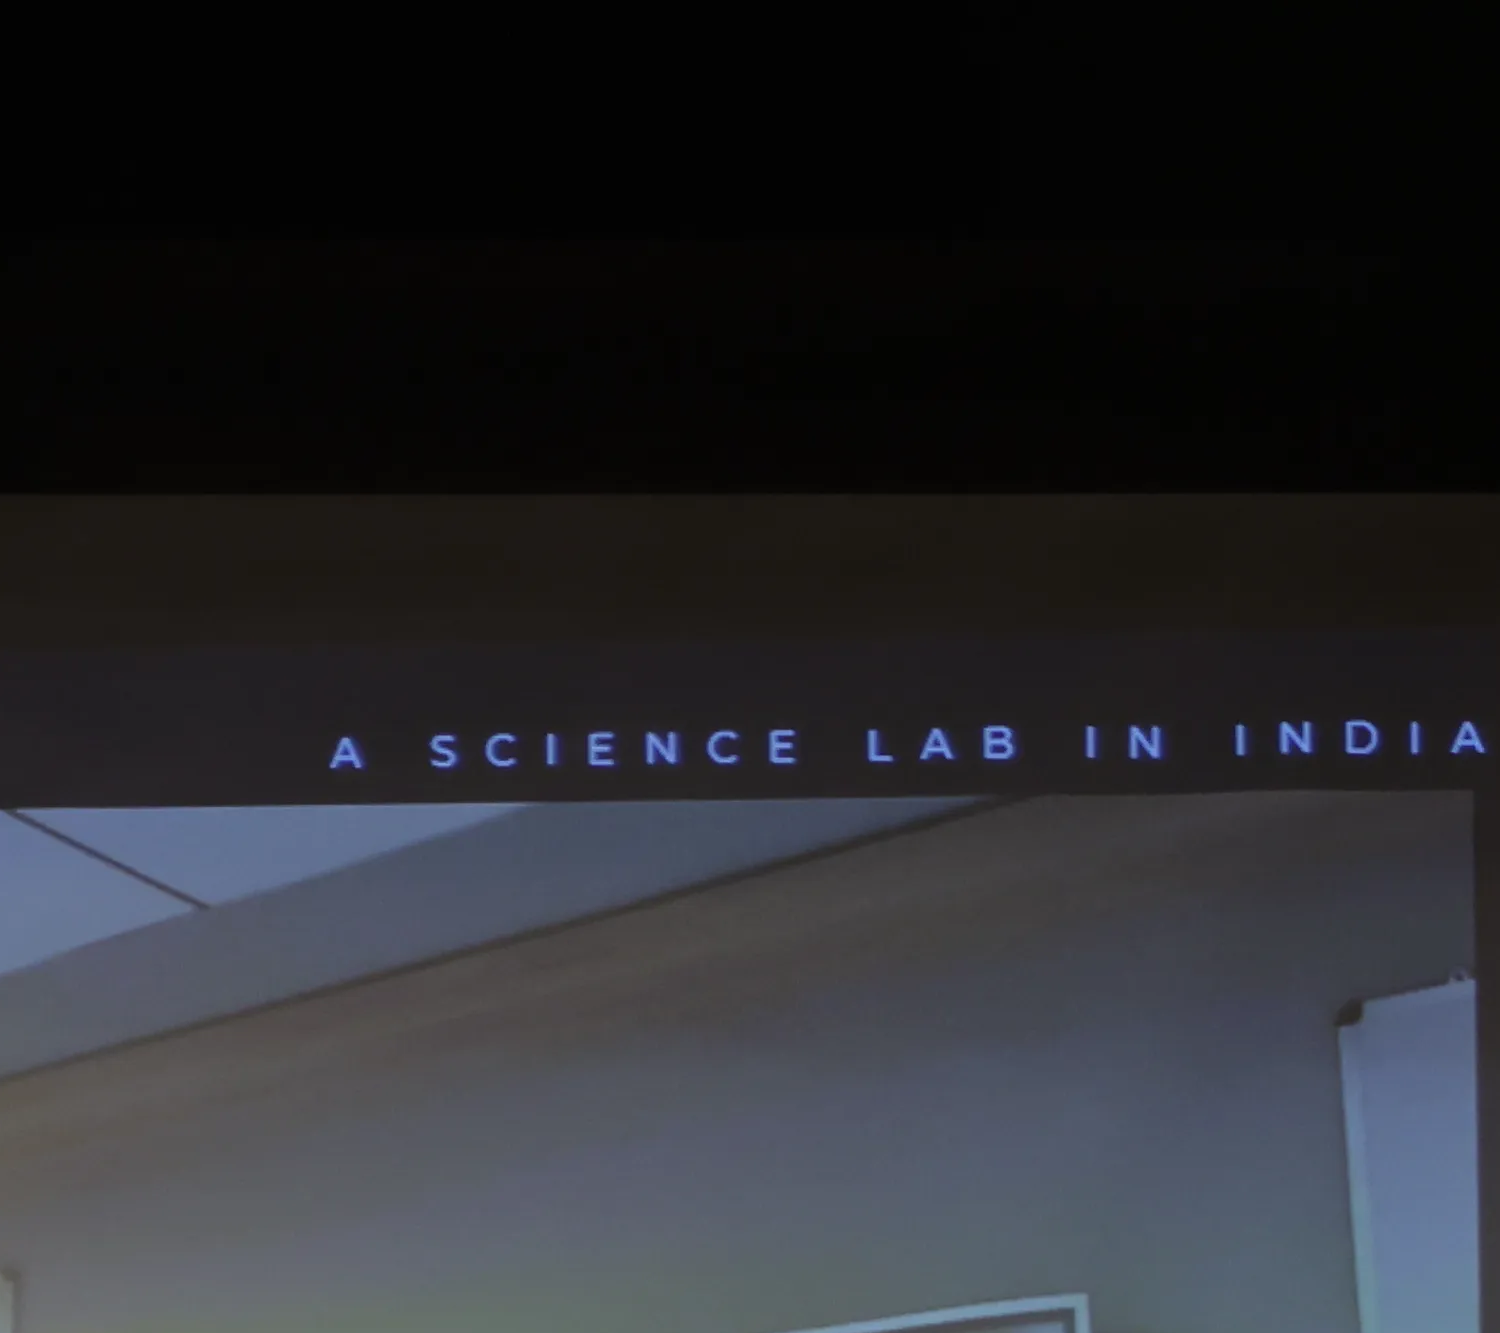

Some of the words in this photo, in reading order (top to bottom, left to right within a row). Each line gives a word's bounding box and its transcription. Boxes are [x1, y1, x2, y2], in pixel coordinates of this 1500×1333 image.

[329, 736, 362, 769] A
[428, 729, 797, 769] SCIENCE
[866, 725, 1017, 763] LAB
[1084, 724, 1163, 761] IN
[1235, 719, 1487, 758] INDIA
